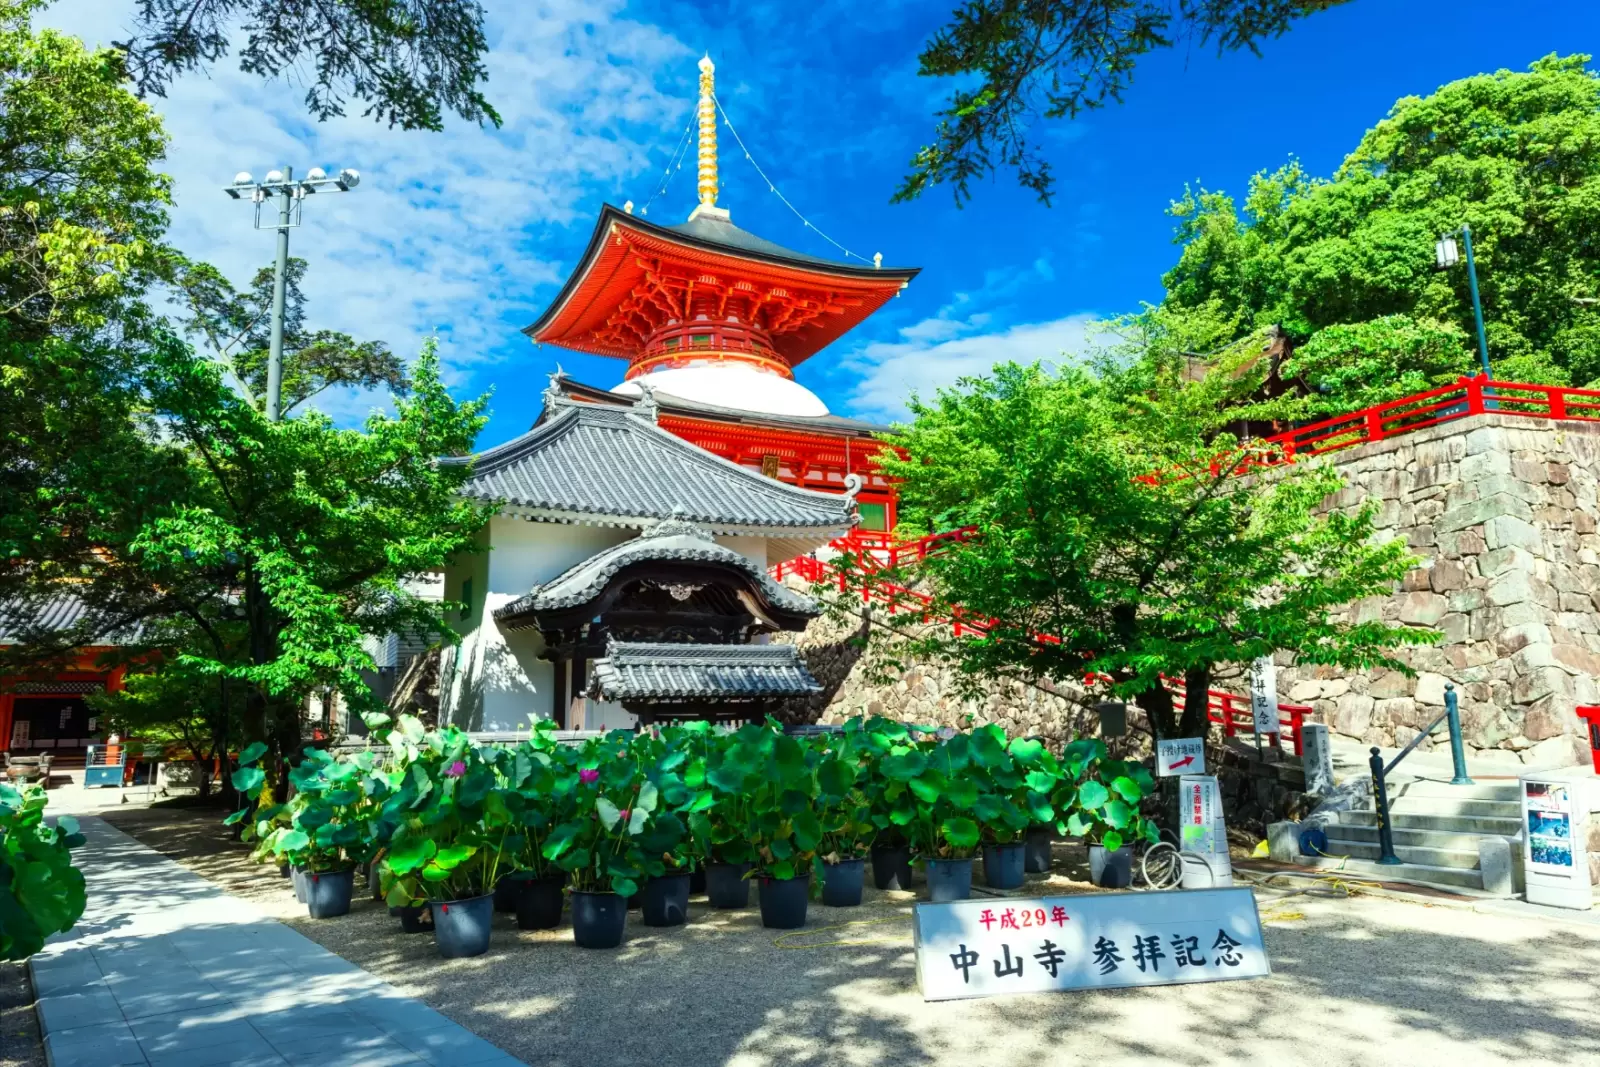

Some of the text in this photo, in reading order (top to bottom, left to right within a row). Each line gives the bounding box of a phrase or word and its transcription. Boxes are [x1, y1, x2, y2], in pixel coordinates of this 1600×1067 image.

[979, 905, 1070, 931] 平成29年
[949, 928, 1244, 984] 中山寺 参拝記念
